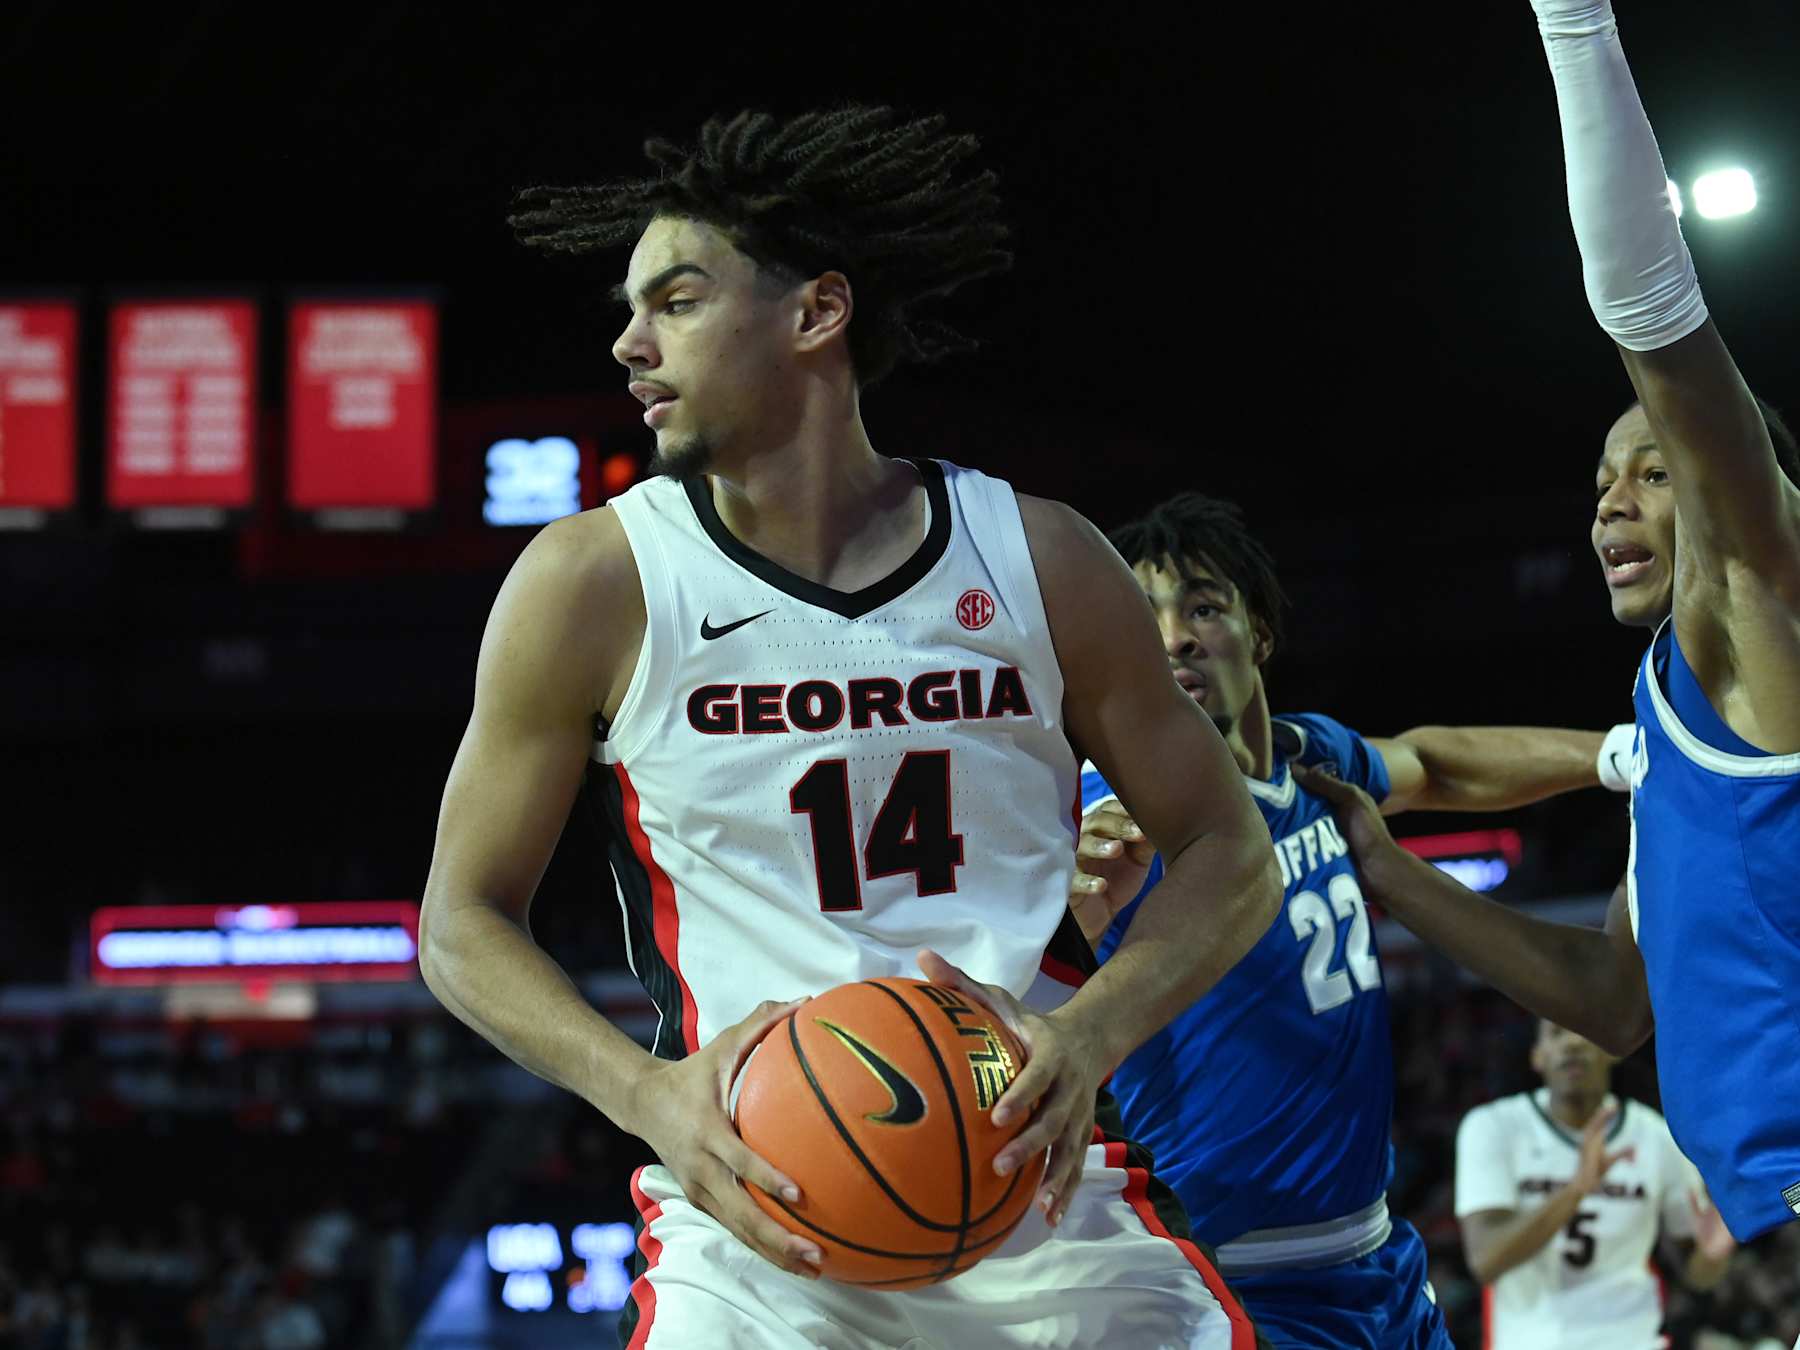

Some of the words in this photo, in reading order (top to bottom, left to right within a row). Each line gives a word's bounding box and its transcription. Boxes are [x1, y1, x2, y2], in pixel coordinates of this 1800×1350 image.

[960, 593, 991, 627] SEC
[687, 667, 1033, 735] GEORGIA
[789, 749, 964, 912] 14
[1288, 872, 1382, 1015] 22
[1563, 1212, 1598, 1268] 5
